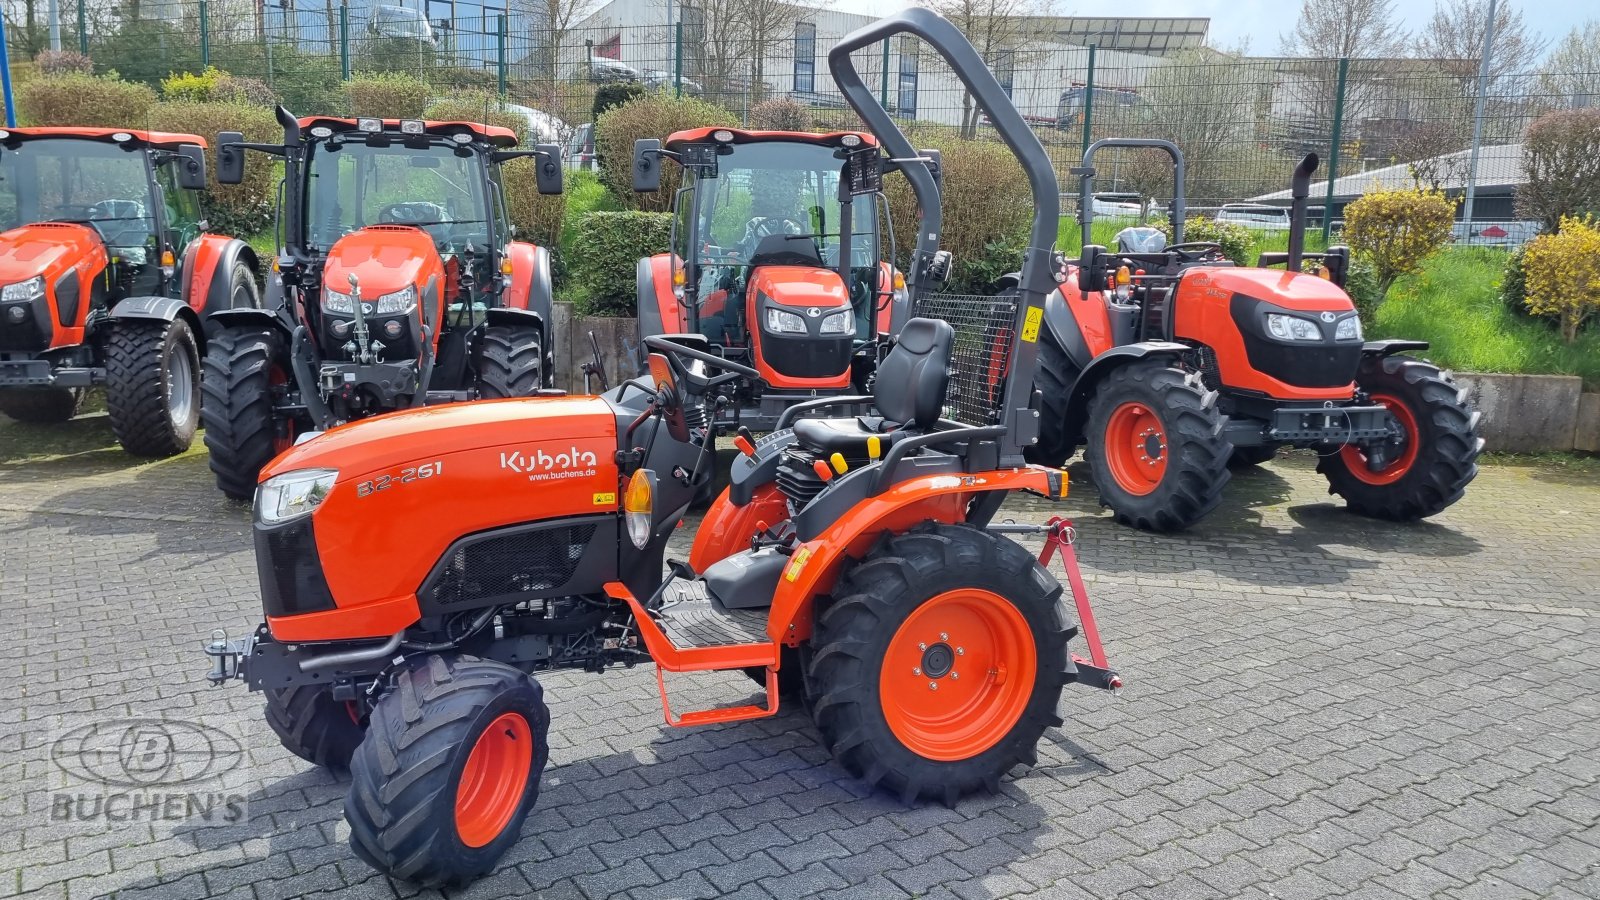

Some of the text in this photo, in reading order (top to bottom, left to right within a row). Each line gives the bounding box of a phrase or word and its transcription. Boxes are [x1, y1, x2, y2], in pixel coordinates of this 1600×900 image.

[501, 446, 597, 472] Kubota
[357, 461, 443, 498] B2-261
[529, 469, 596, 481] www.buchens.de
